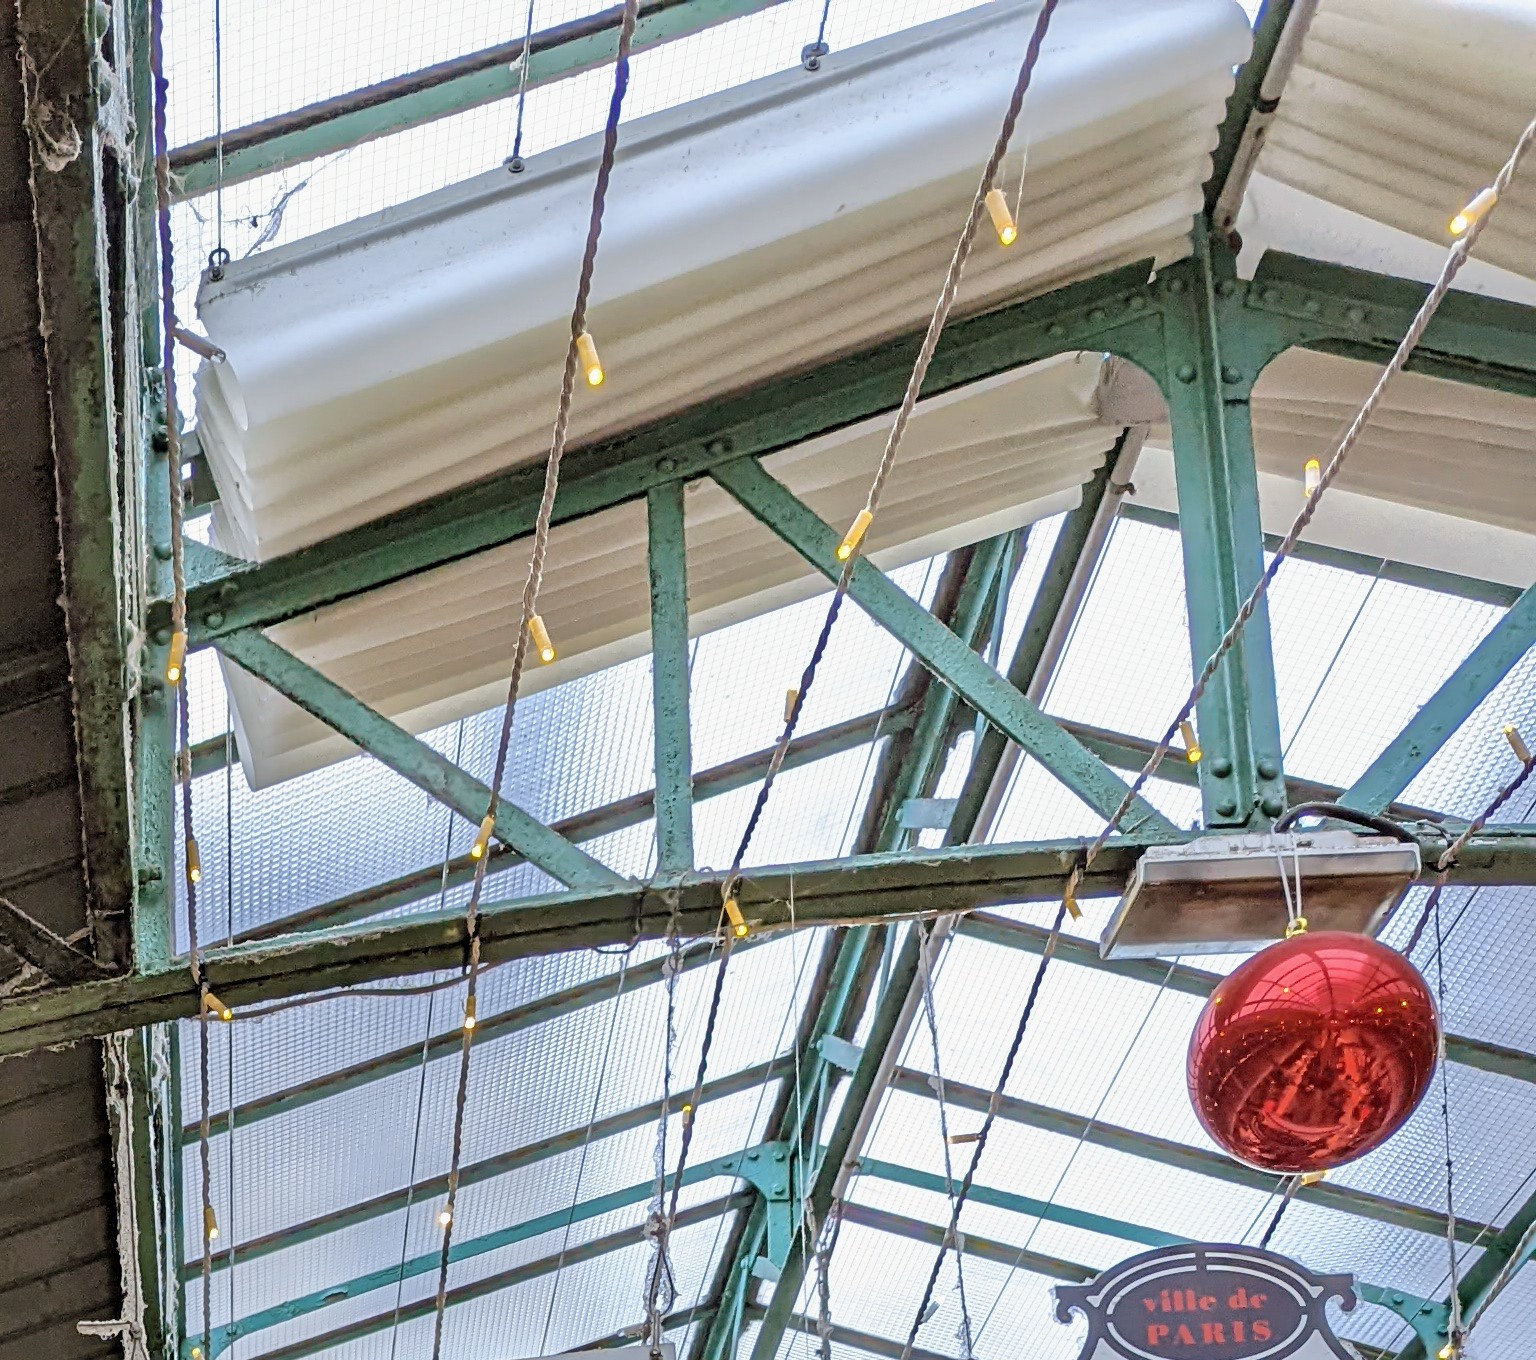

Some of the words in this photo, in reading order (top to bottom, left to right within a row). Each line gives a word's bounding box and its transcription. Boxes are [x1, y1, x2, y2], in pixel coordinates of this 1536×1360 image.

[1142, 1288, 1217, 1313] ville
[1227, 1286, 1269, 1311] de
[1145, 1319, 1273, 1347] PARIS
